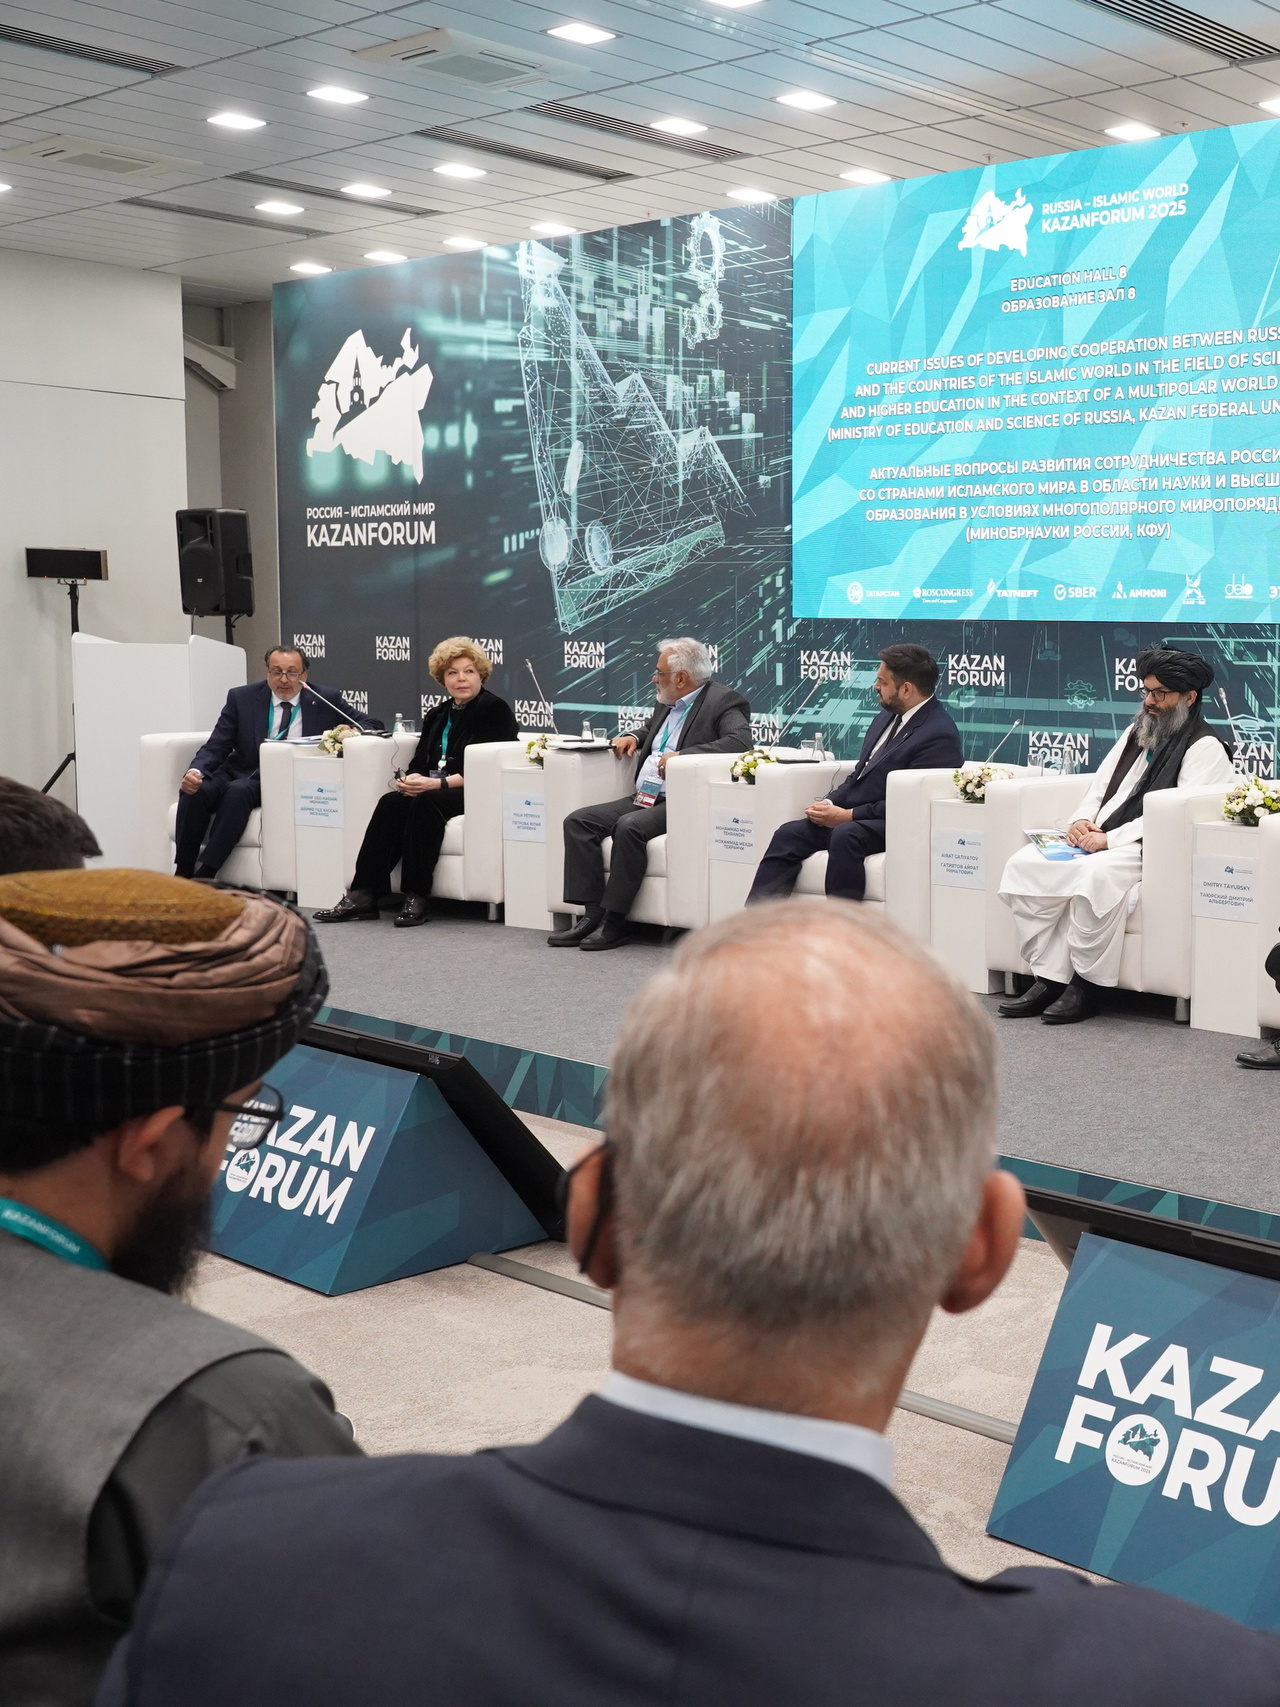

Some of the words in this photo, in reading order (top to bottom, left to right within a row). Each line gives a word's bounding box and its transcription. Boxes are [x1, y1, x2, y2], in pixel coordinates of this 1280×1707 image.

[1042, 199, 1082, 215] RUSSIA
[1093, 190, 1139, 208] ISLAMIC
[1143, 183, 1189, 200] WORLD
[1042, 208, 1144, 233] KAZANFORUM
[1149, 200, 1186, 220] 2025
[1010, 272, 1081, 292] EDUCATION
[1084, 268, 1116, 283] HALL
[1119, 265, 1127, 279] 8
[1002, 291, 1095, 313] ОБРАЗОВАНИЕ
[1098, 289, 1125, 303] ЗАЛ
[1128, 287, 1136, 300] 8
[866, 359, 920, 376] CURRENT
[923, 355, 964, 370] ISSUES
[967, 353, 983, 367] OF
[987, 345, 1067, 365] DEVELOPING
[1071, 336, 1168, 358] COOPERATION
[1172, 329, 1243, 349] BETWEEN
[855, 383, 880, 397] AND
[883, 382, 905, 395] THE
[908, 377, 975, 394] COUNTRIES
[979, 375, 996, 388] OF
[999, 372, 1022, 386] THE
[1026, 367, 1077, 384] ISLAMIC
[1081, 363, 1131, 379] WORLD
[1135, 362, 1149, 375] IN
[1152, 358, 1180, 374] THE
[1184, 355, 1224, 372] FIELD
[1228, 353, 1249, 368] OF
[840, 406, 865, 420] AND
[868, 401, 912, 418] HIGHER
[915, 397, 984, 414] EDUCATION
[988, 396, 1000, 409] IN
[1003, 394, 1027, 408] THE
[1031, 388, 1090, 406] CONTEXT
[1093, 387, 1111, 402] OF
[1114, 386, 1124, 400] A
[1128, 379, 1217, 399] MULTIPOLAR
[1221, 375, 1278, 392] WORLD
[827, 425, 883, 444] (MINISTRY
[886, 425, 901, 437] OF
[904, 420, 973, 436] EDUCATION
[976, 418, 1003, 432] AND
[1006, 415, 1060, 430] SCIENCE
[1063, 412, 1081, 425] OF
[1084, 411, 1136, 426] RUSSIA,
[1139, 405, 1187, 422] KAZAN
[1190, 401, 1257, 418] FEDERAL
[869, 466, 951, 480] АКТУАЛЬНЫЕ
[954, 461, 1018, 477] ВОПРОСЫ
[1021, 457, 1091, 474] РАЗВИТИЯ
[1094, 451, 1226, 471] СОТРУДНИЧЕСТВА
[859, 489, 875, 501] СО
[878, 486, 944, 500] СТРАНАМИ
[948, 482, 1034, 499] ИСЛАМСКОГО
[1038, 480, 1077, 495] МИРА
[1080, 480, 1088, 493] В
[1092, 477, 1158, 493] ОБЛАСТИ
[1162, 475, 1211, 491] НАУКИ
[1216, 474, 1226, 488] И
[307, 507, 342, 519] РОССИЯ
[351, 501, 410, 518] ИСЛАМСКИЙ
[413, 503, 435, 515] МИР
[866, 507, 956, 522] ОБРАЗОВАНИЯ
[959, 507, 967, 519] В
[970, 504, 1040, 519] УСЛОВИЯХ
[1042, 500, 1176, 516] МНОГОПОЛЯРНОГО
[307, 521, 436, 547] KAZANFORUM
[966, 524, 1070, 543] (МИНОБРНАУКИ
[1073, 523, 1134, 539] РОССИИ,
[1137, 523, 1171, 540] КФУ)
[922, 588, 973, 596] ROSCONGRESS
[996, 590, 1038, 598] TATNEFT
[1069, 587, 1096, 598] SBER
[1129, 589, 1166, 598] AMMONI
[294, 634, 325, 646] KAZAN
[376, 636, 410, 649] KAZAN
[564, 641, 605, 655] KAZAN
[376, 648, 410, 661] FORUM
[564, 655, 605, 669] FORUM
[801, 651, 850, 665] KAZAN
[948, 654, 1004, 671] KAZAN
[801, 666, 851, 680] FORUM
[948, 671, 1004, 686] FORUM
[515, 700, 553, 714] KAZAN
[515, 714, 554, 727] FORUM
[1029, 731, 1088, 749] KAZAN
[266, 1105, 376, 1172] ZAN
[220, 1143, 353, 1224] ORUM
